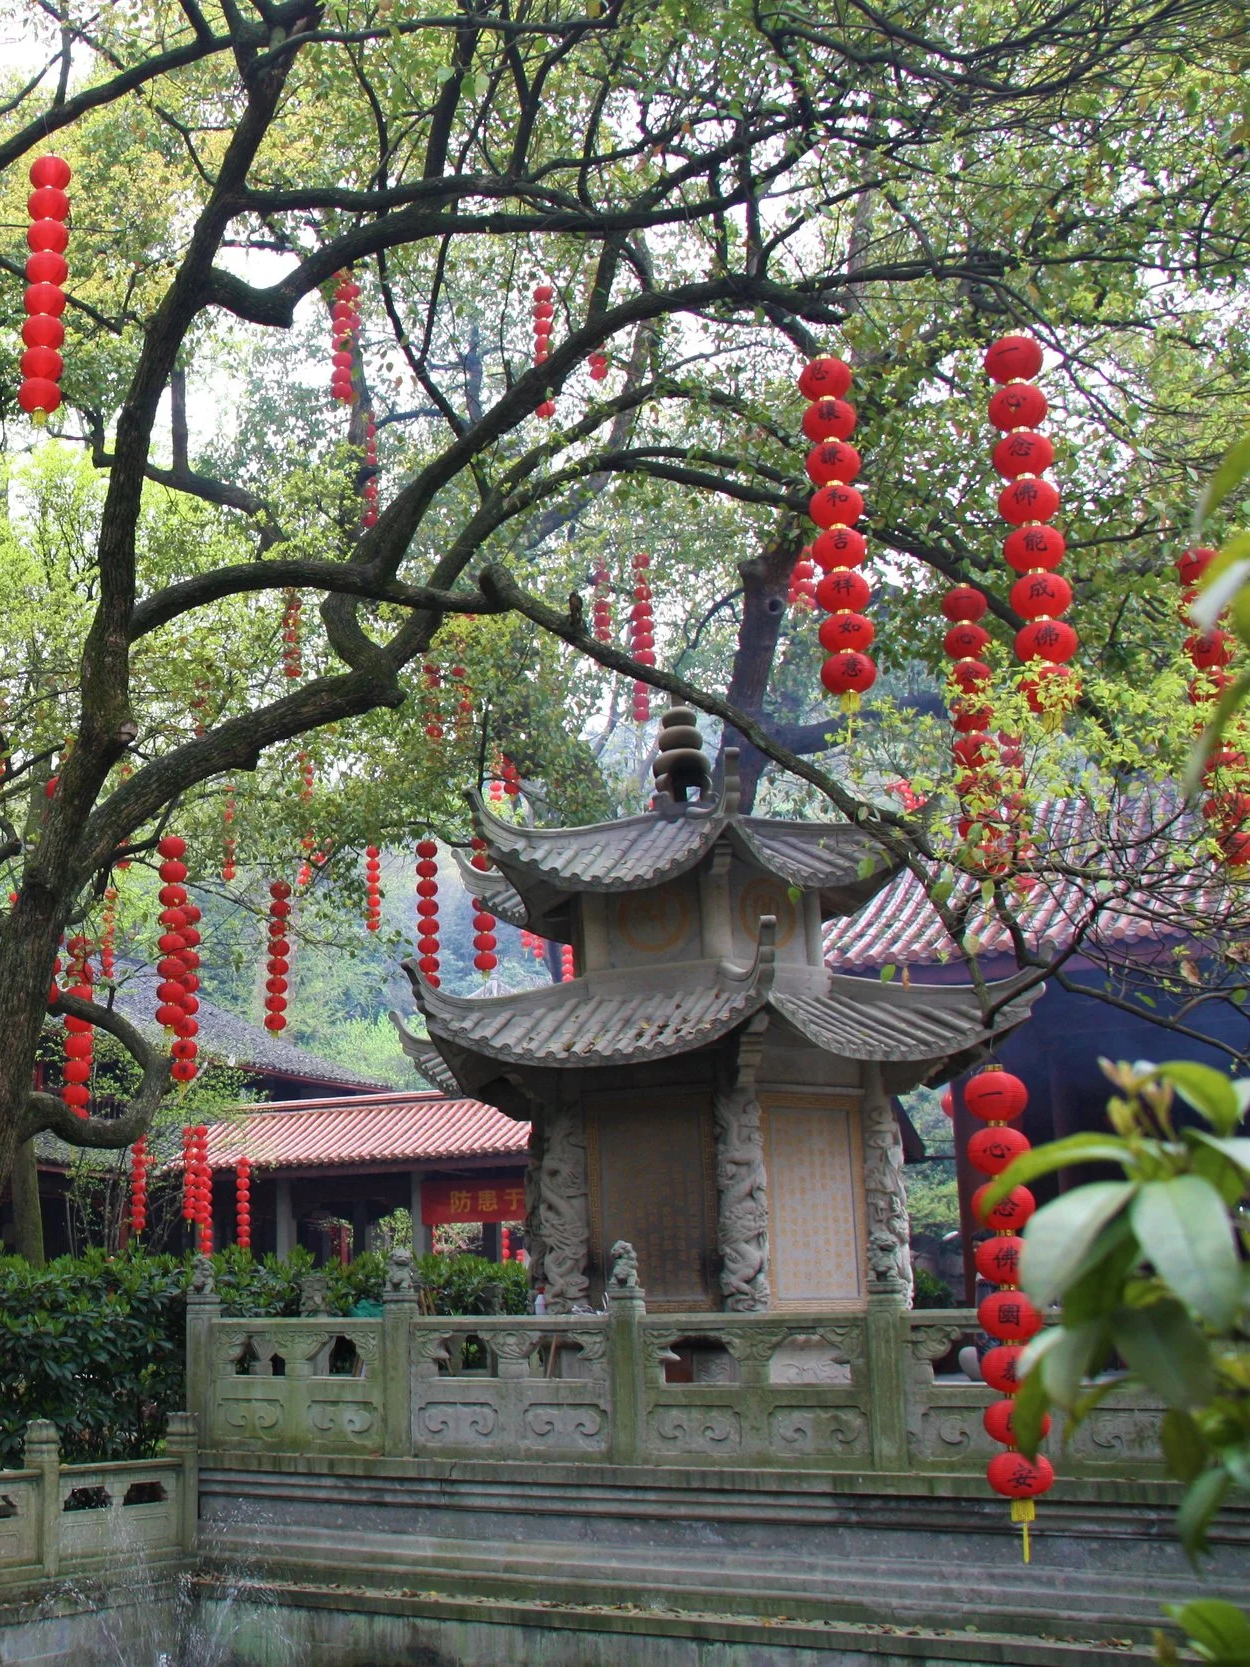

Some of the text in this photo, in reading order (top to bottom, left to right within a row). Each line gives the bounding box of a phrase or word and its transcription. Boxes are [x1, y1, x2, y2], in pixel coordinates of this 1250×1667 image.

[996, 346, 1060, 647] 一心念佛能成佛
